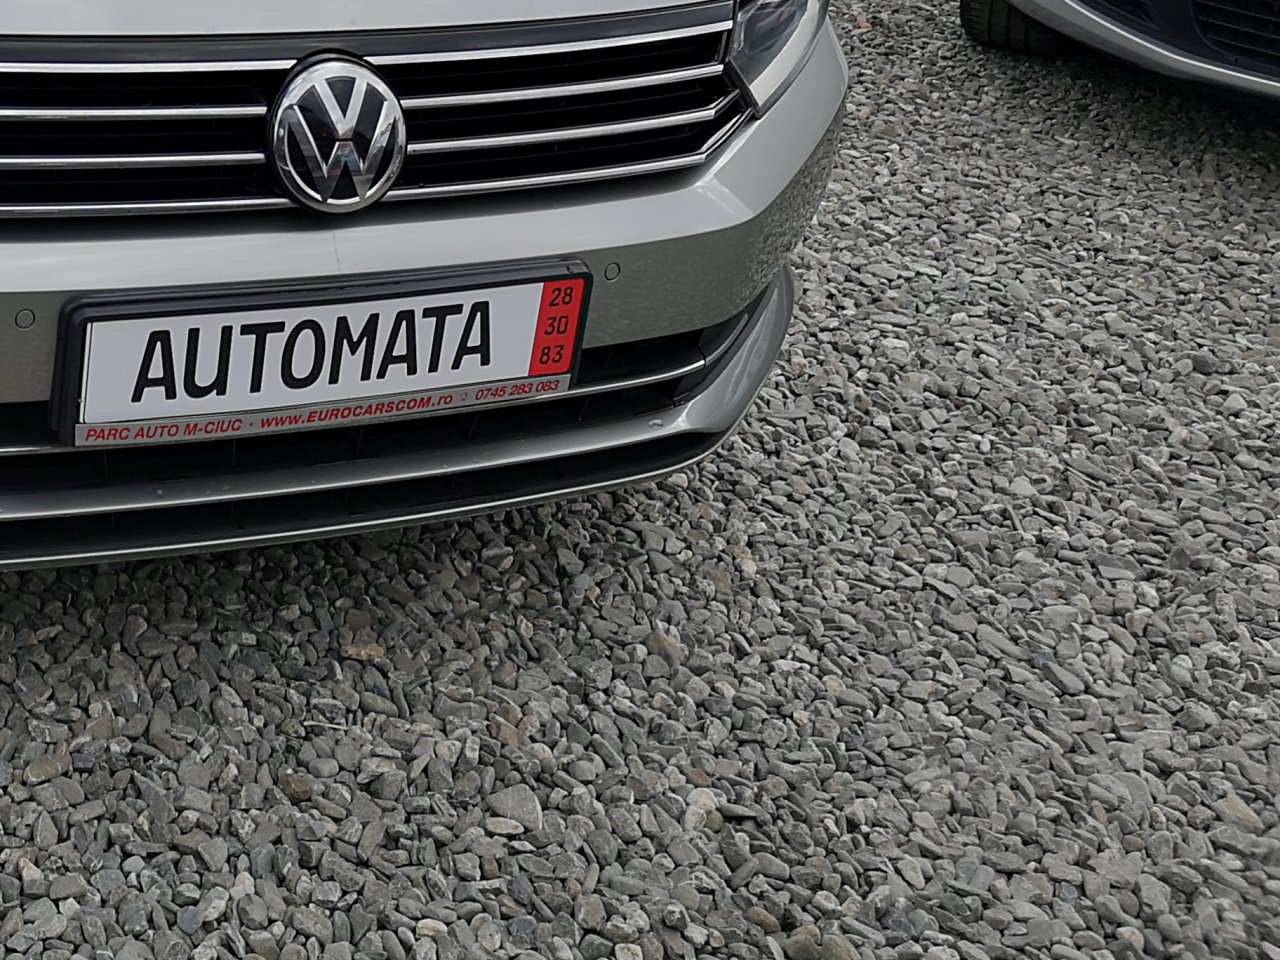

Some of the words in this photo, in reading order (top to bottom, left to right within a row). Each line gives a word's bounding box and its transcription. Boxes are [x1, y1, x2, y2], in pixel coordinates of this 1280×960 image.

[549, 287, 574, 307] 28
[544, 316, 569, 336] 30
[130, 300, 491, 403] AUTOMATA
[538, 345, 565, 365] 83
[85, 427, 131, 442] PARC
[134, 424, 179, 440] AUTO
[183, 419, 243, 436] M-CIUC
[260, 394, 454, 429] www.EUROCARSCOM.ro
[475, 387, 507, 401] 0745
[508, 383, 534, 396] 283
[535, 379, 560, 393] 083
